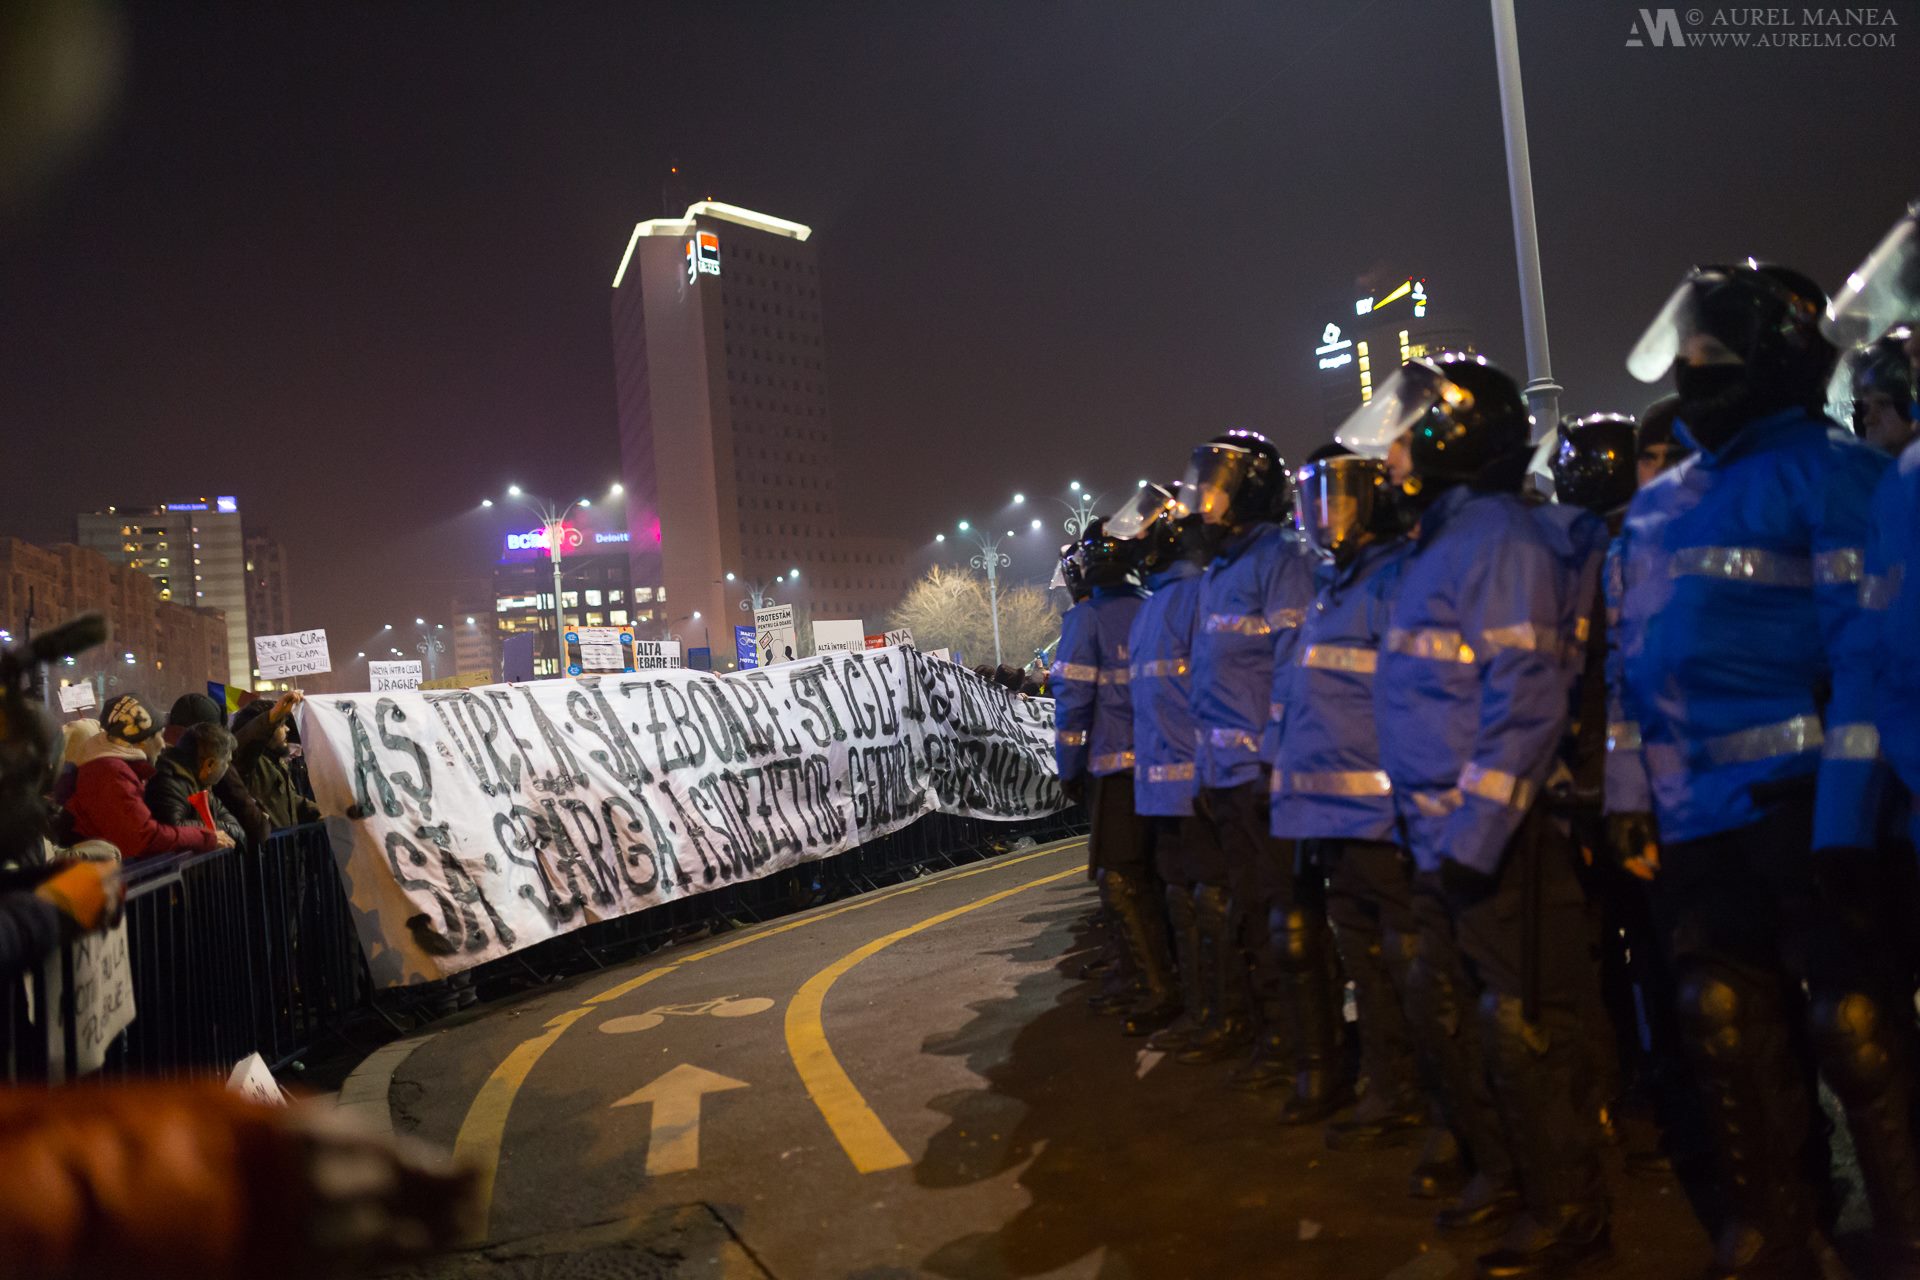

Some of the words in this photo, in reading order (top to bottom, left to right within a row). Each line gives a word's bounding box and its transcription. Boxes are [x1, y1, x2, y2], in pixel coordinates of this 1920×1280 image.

[637, 657, 667, 669] EBARE
[620, 672, 802, 775] ZBOARE
[789, 654, 902, 748] STICLE
